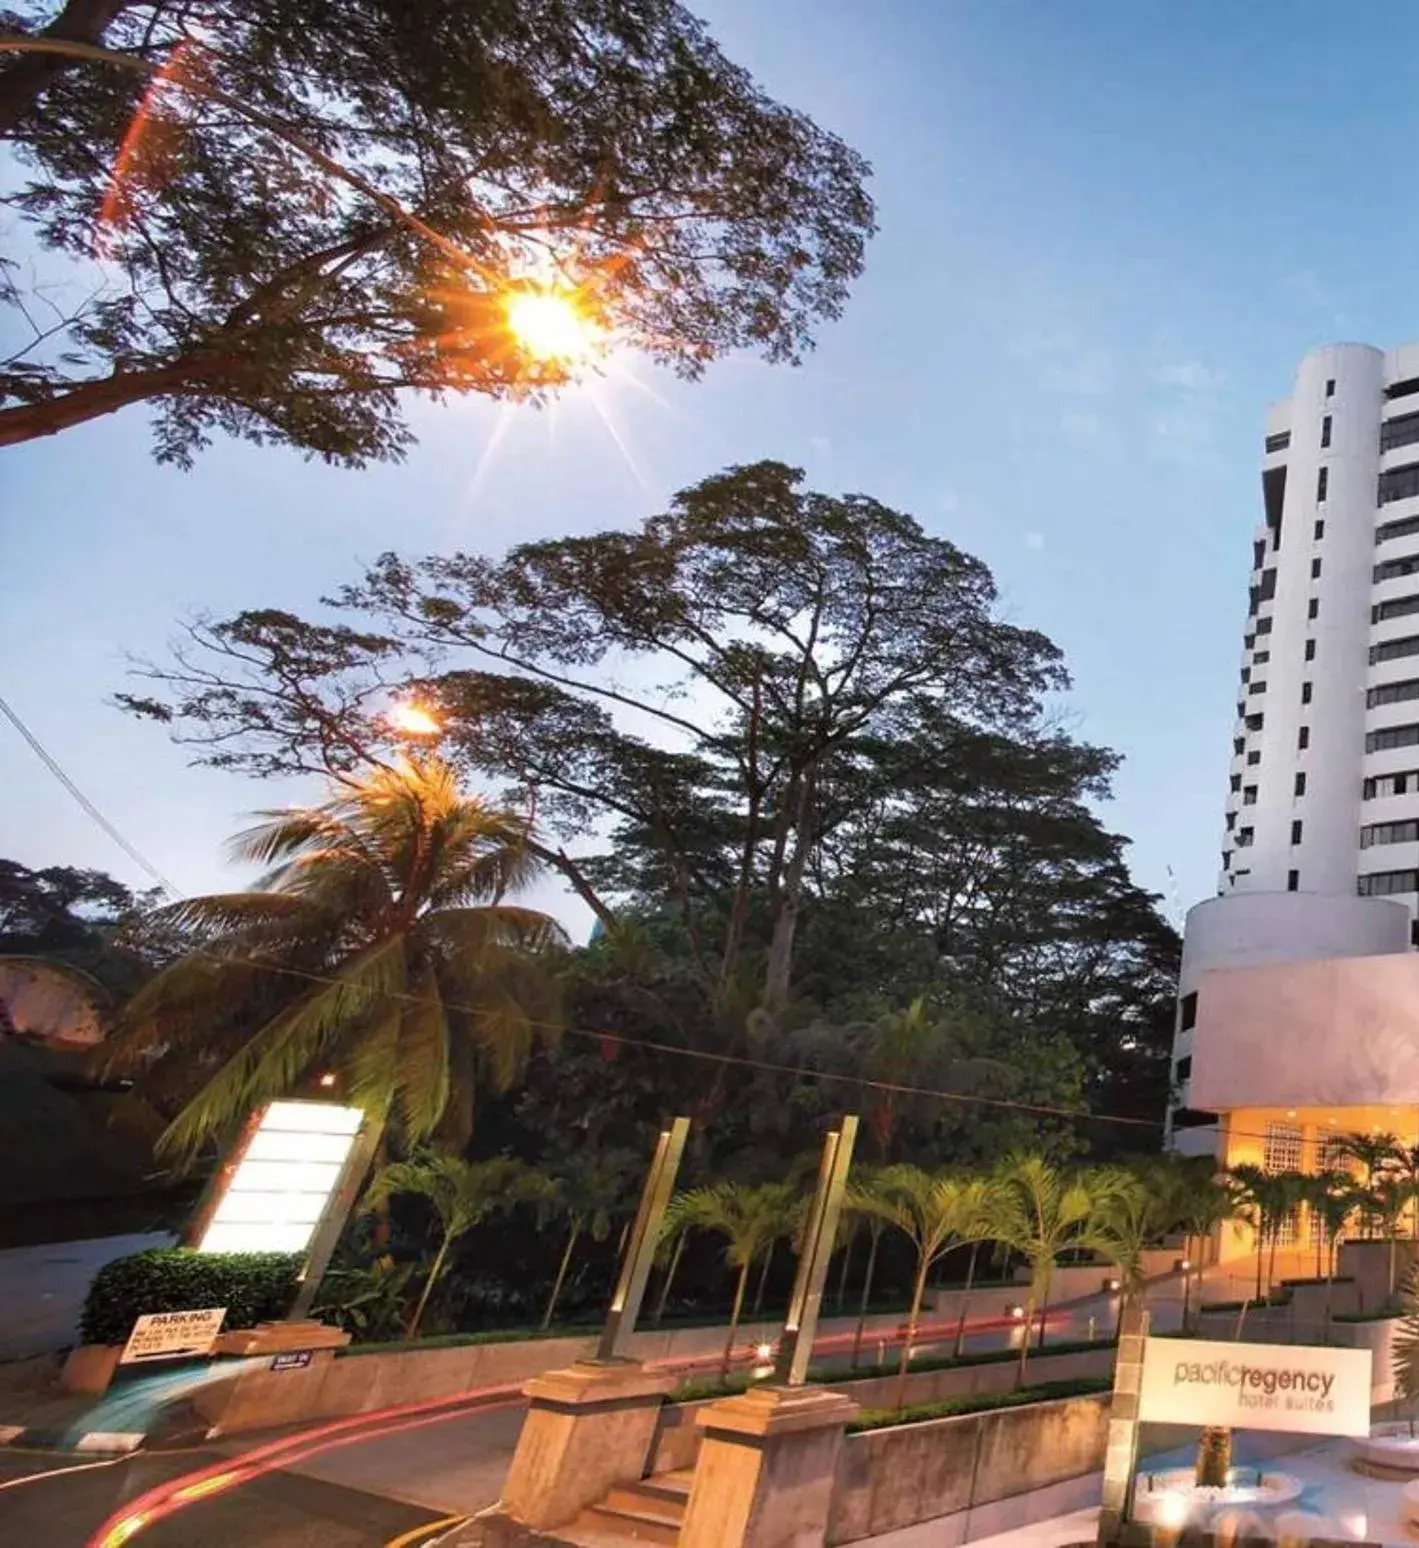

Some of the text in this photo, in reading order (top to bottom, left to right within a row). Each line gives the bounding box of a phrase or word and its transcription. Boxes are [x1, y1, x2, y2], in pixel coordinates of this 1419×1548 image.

[151, 1311, 212, 1325] PARKING
[1238, 1392, 1335, 1413] hotel suites
